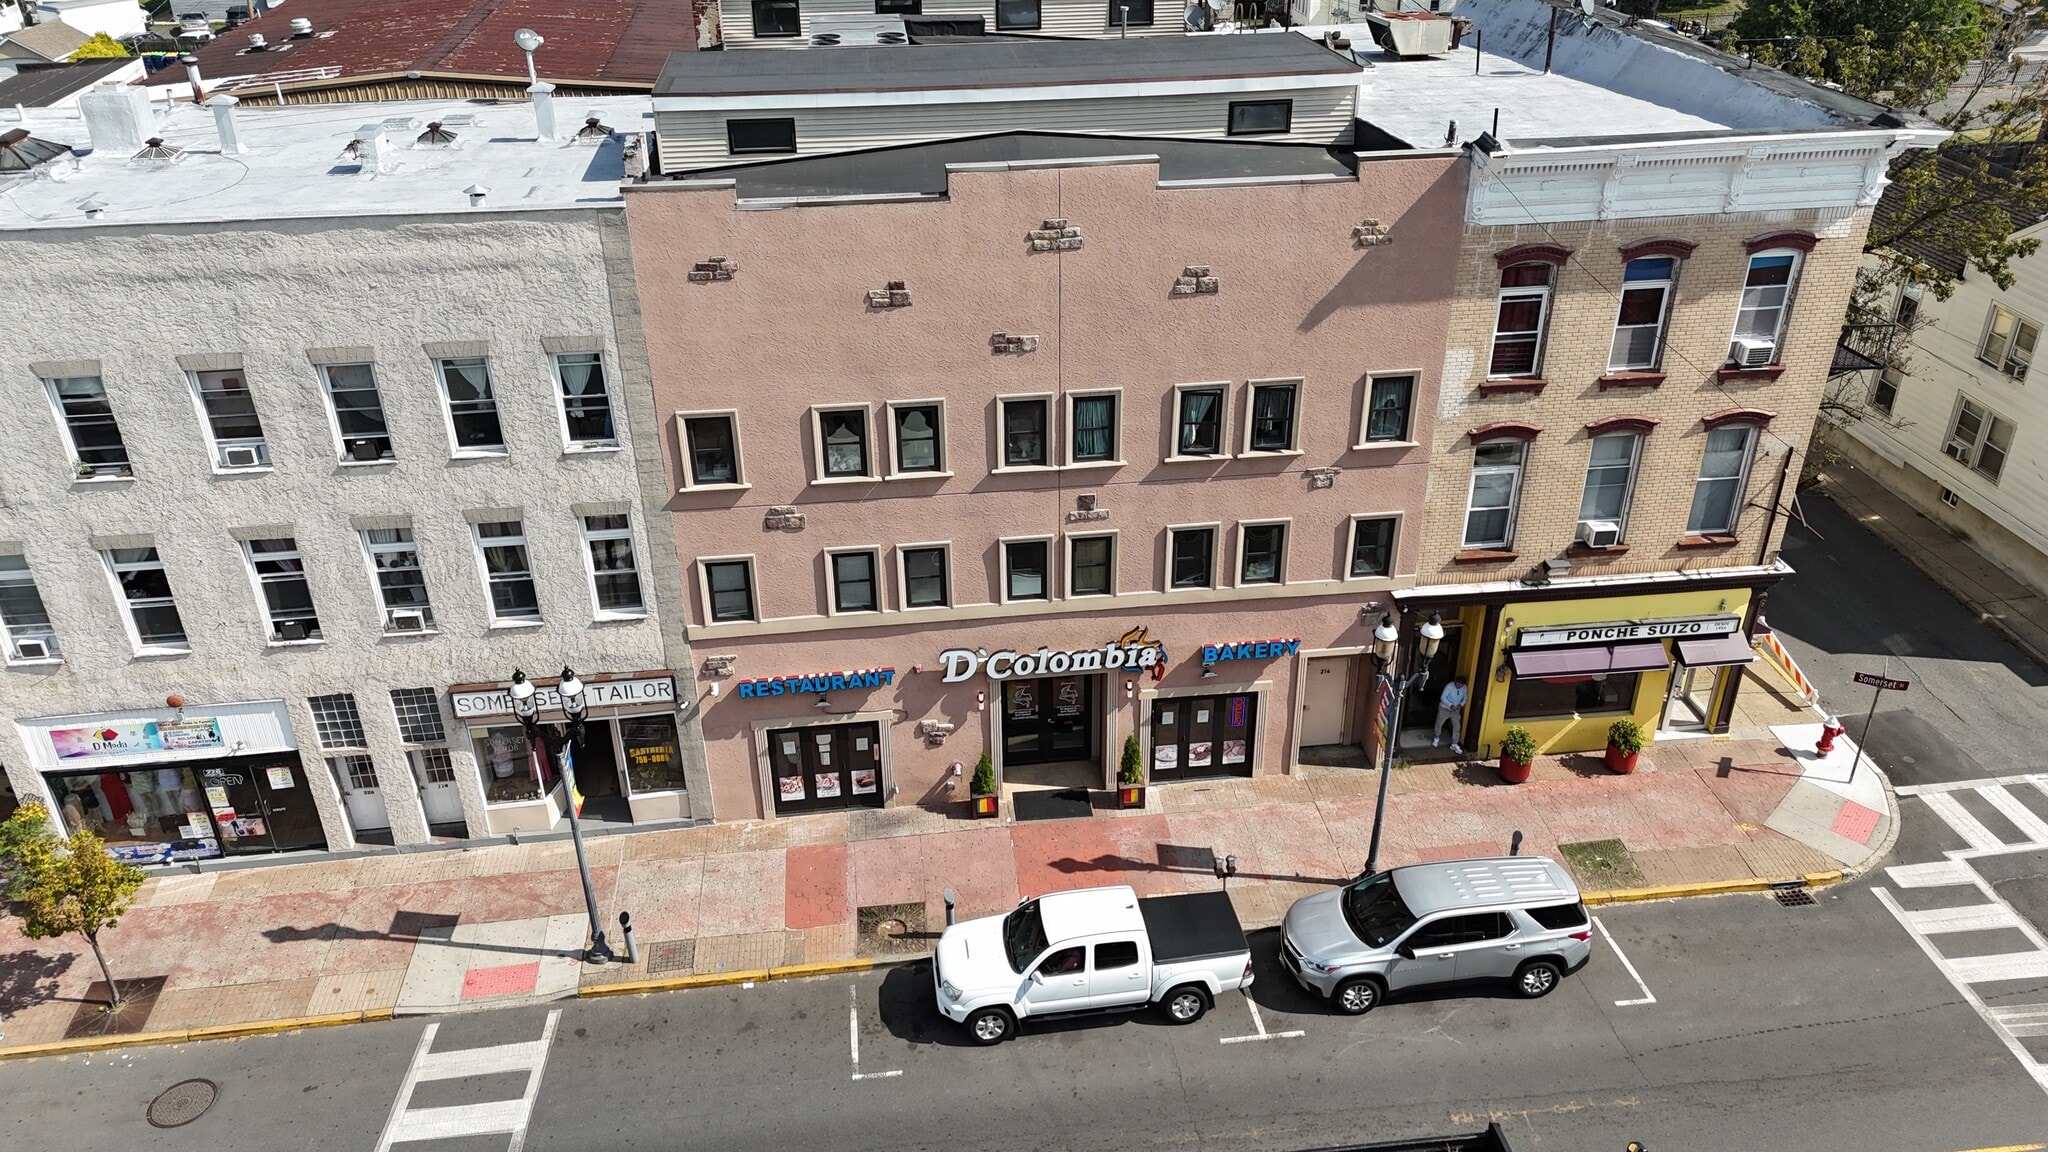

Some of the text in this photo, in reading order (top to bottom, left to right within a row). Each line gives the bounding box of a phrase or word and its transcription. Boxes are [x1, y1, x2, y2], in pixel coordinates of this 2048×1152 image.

[1566, 622, 1702, 641] PONCHE SUIZO
[1204, 640, 1301, 663] BAKERY
[738, 668, 896, 699] RESTAURANT
[1858, 673, 1898, 689] Somerset
[456, 681, 671, 713] SOMESE TAILOR
[92, 740, 128, 751] D Moda
[210, 776, 243, 786] OPEN
